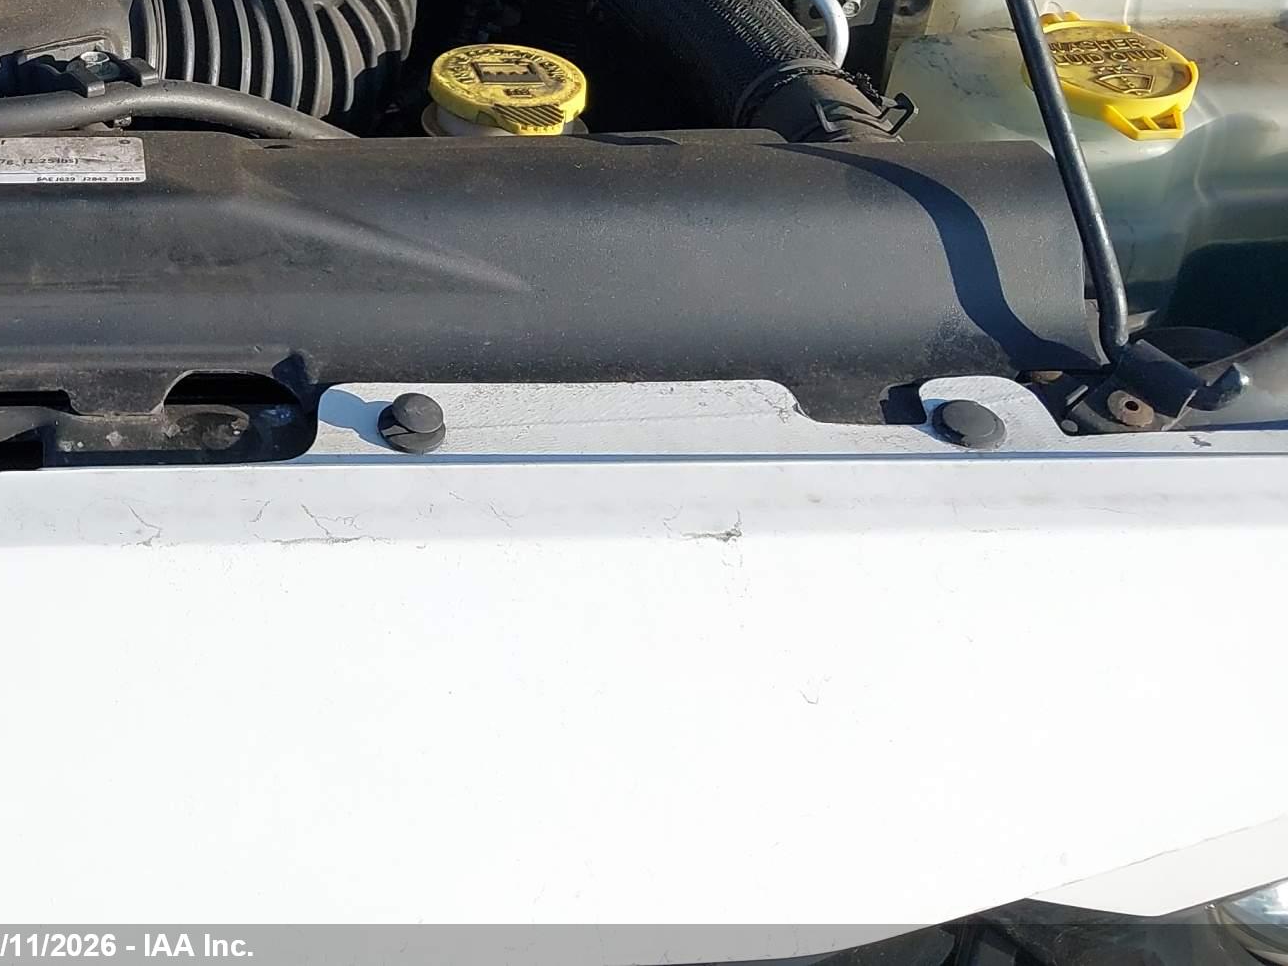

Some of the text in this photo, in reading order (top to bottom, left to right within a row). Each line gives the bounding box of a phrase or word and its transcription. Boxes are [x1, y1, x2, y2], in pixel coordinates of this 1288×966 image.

[1048, 38, 1146, 53] WASHER
[1052, 49, 1168, 66] LUID ONLY
